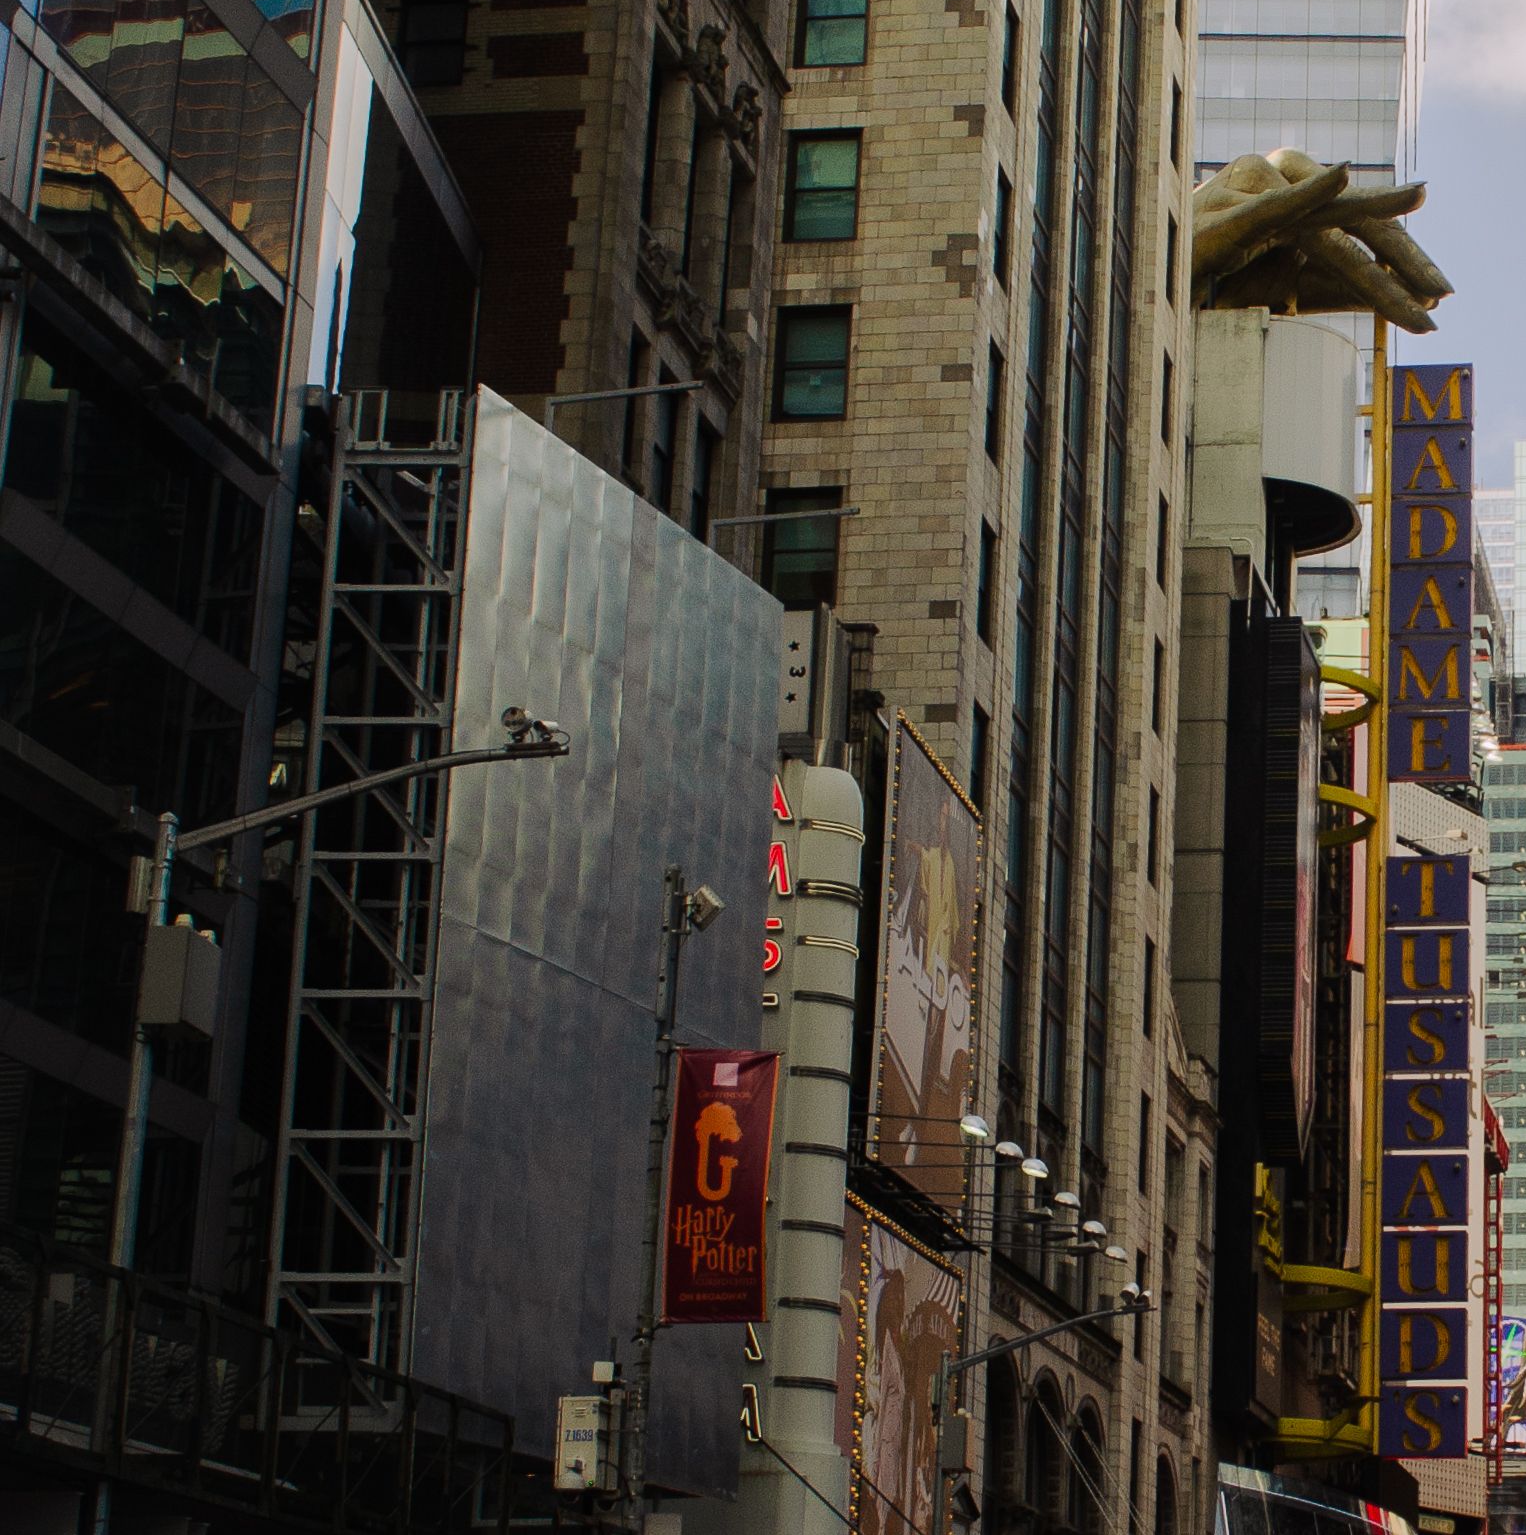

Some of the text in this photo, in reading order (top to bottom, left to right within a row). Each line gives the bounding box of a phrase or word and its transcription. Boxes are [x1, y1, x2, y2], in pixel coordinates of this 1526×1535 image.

[1396, 367, 1467, 772] MADAME
[671, 1204, 736, 1247] Harry
[692, 1235, 758, 1280] Potter
